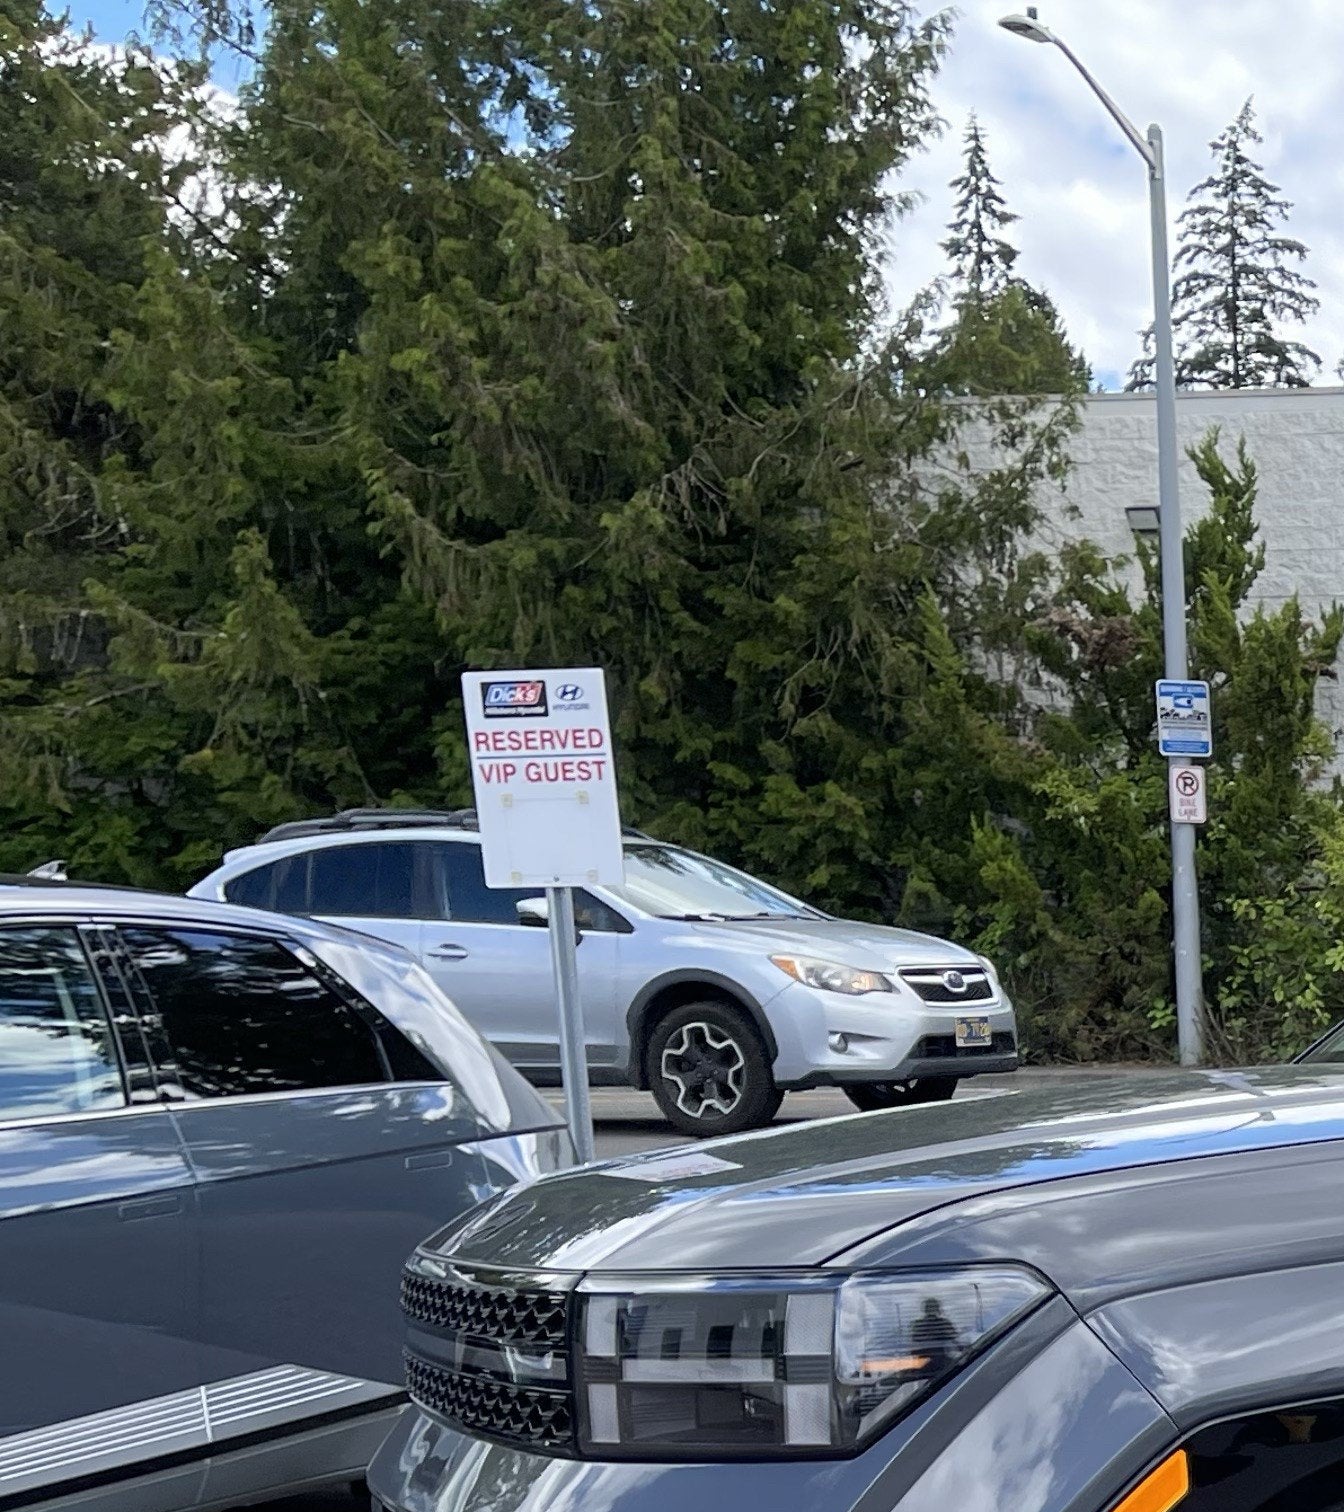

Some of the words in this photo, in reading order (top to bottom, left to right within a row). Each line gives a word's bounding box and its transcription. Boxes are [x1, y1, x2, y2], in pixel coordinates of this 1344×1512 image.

[474, 728, 603, 751] RESERVED
[479, 763, 516, 783] VIP
[525, 760, 606, 782] GUEST
